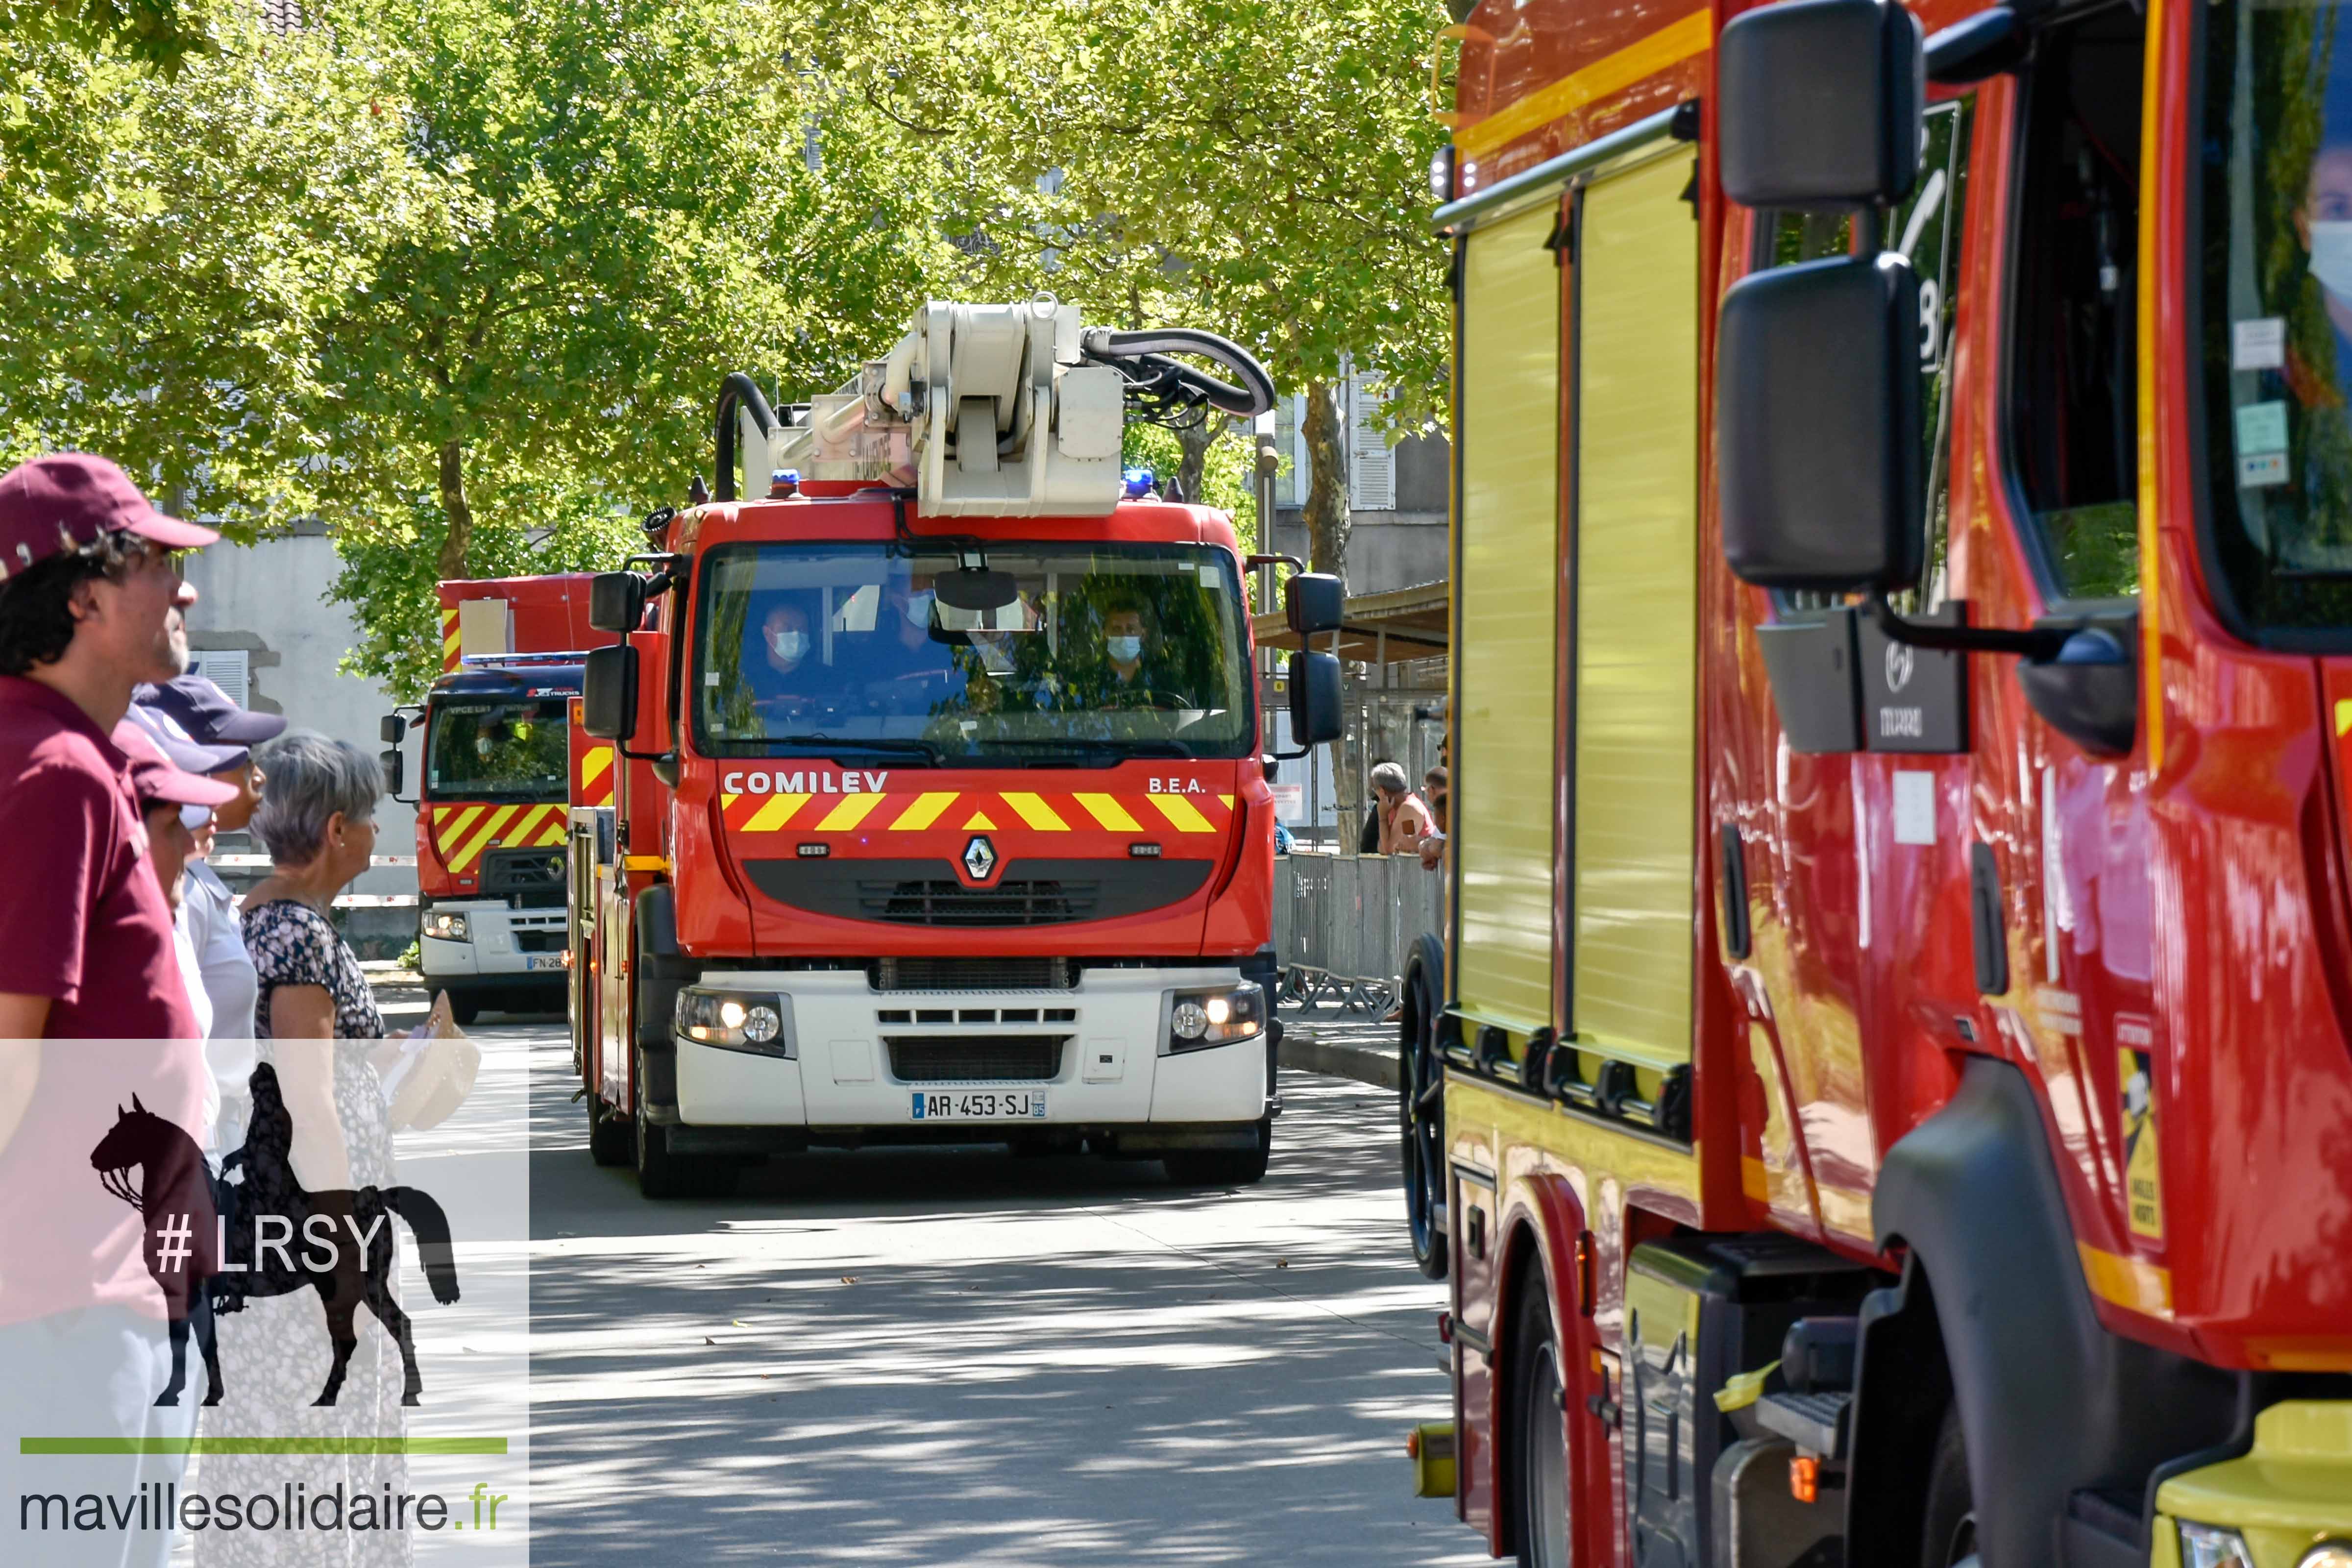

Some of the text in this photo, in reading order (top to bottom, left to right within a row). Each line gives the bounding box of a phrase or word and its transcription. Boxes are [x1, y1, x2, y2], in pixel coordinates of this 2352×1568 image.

[724, 771, 888, 794] COMILEV
[1149, 778, 1205, 793] B.E.A.
[928, 1095, 1029, 1116] AR-453-SJ
[1033, 1104, 1045, 1115] 85
